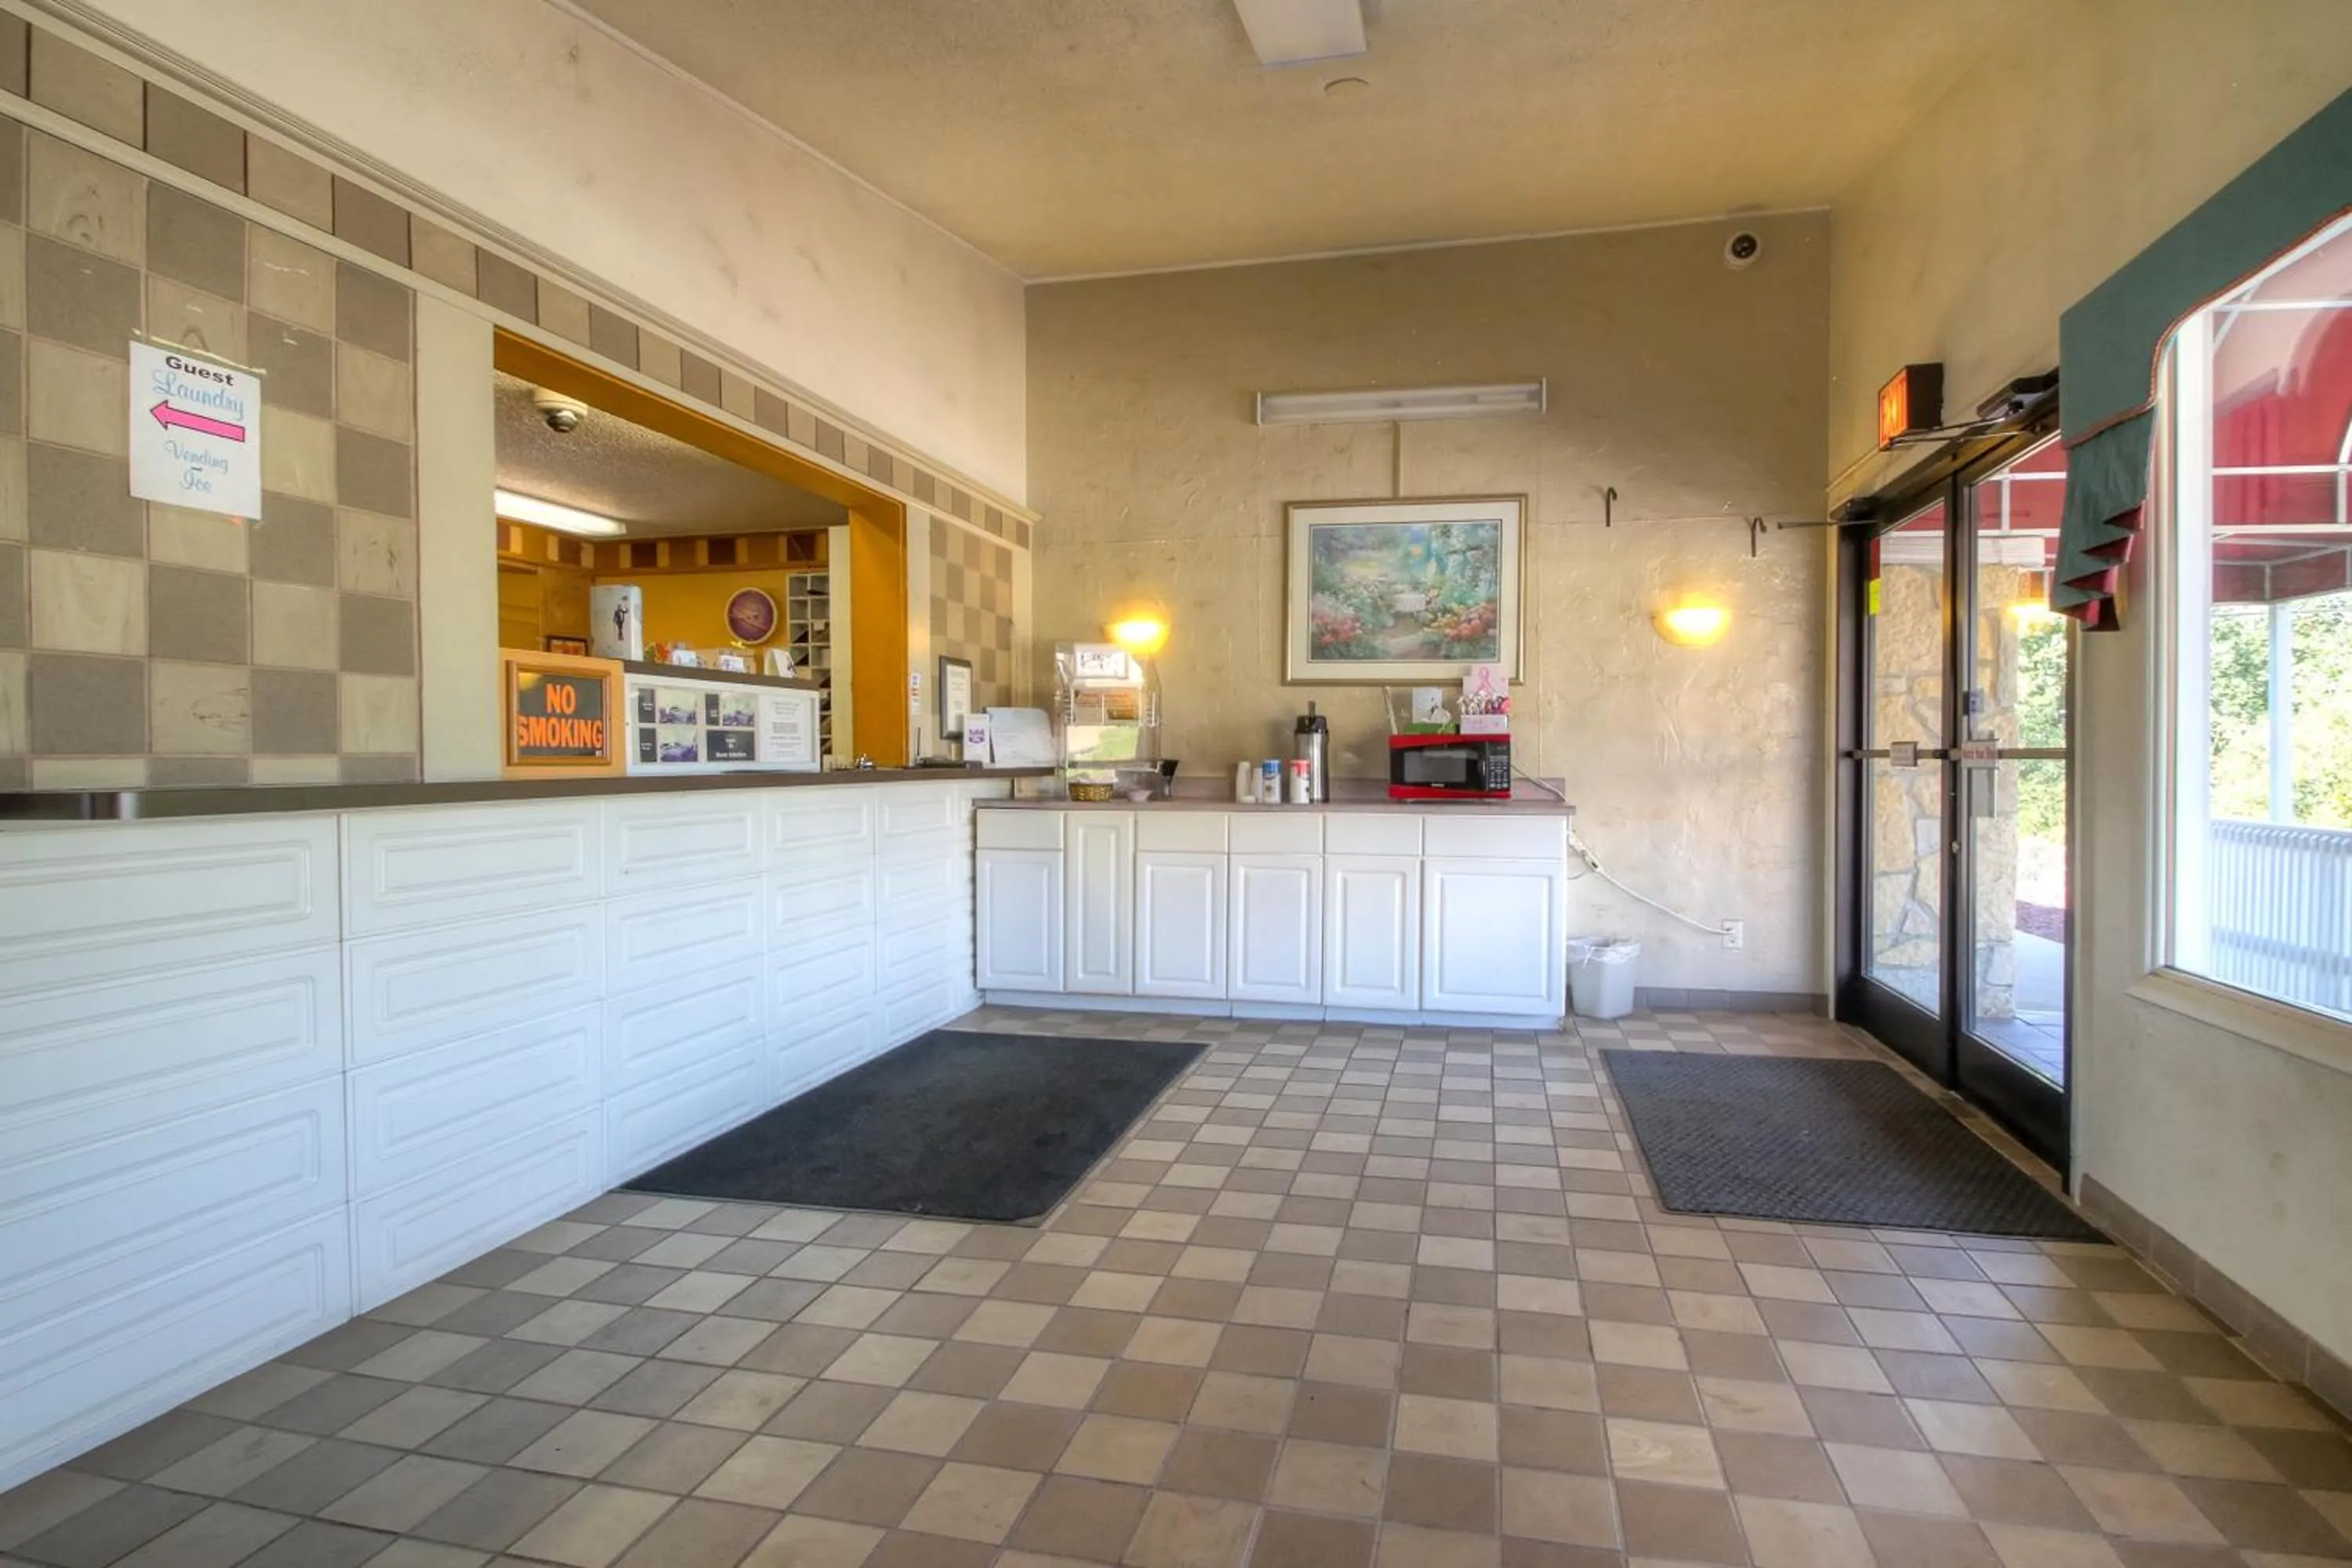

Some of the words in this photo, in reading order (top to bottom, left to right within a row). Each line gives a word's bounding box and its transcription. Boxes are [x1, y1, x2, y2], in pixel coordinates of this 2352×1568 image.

[165, 356, 234, 386] Guest
[152, 369, 243, 421] Laundry
[164, 440, 229, 474] Vending
[180, 470, 212, 494] Ice
[546, 683, 576, 715] NO
[518, 716, 602, 749] SMOKING
